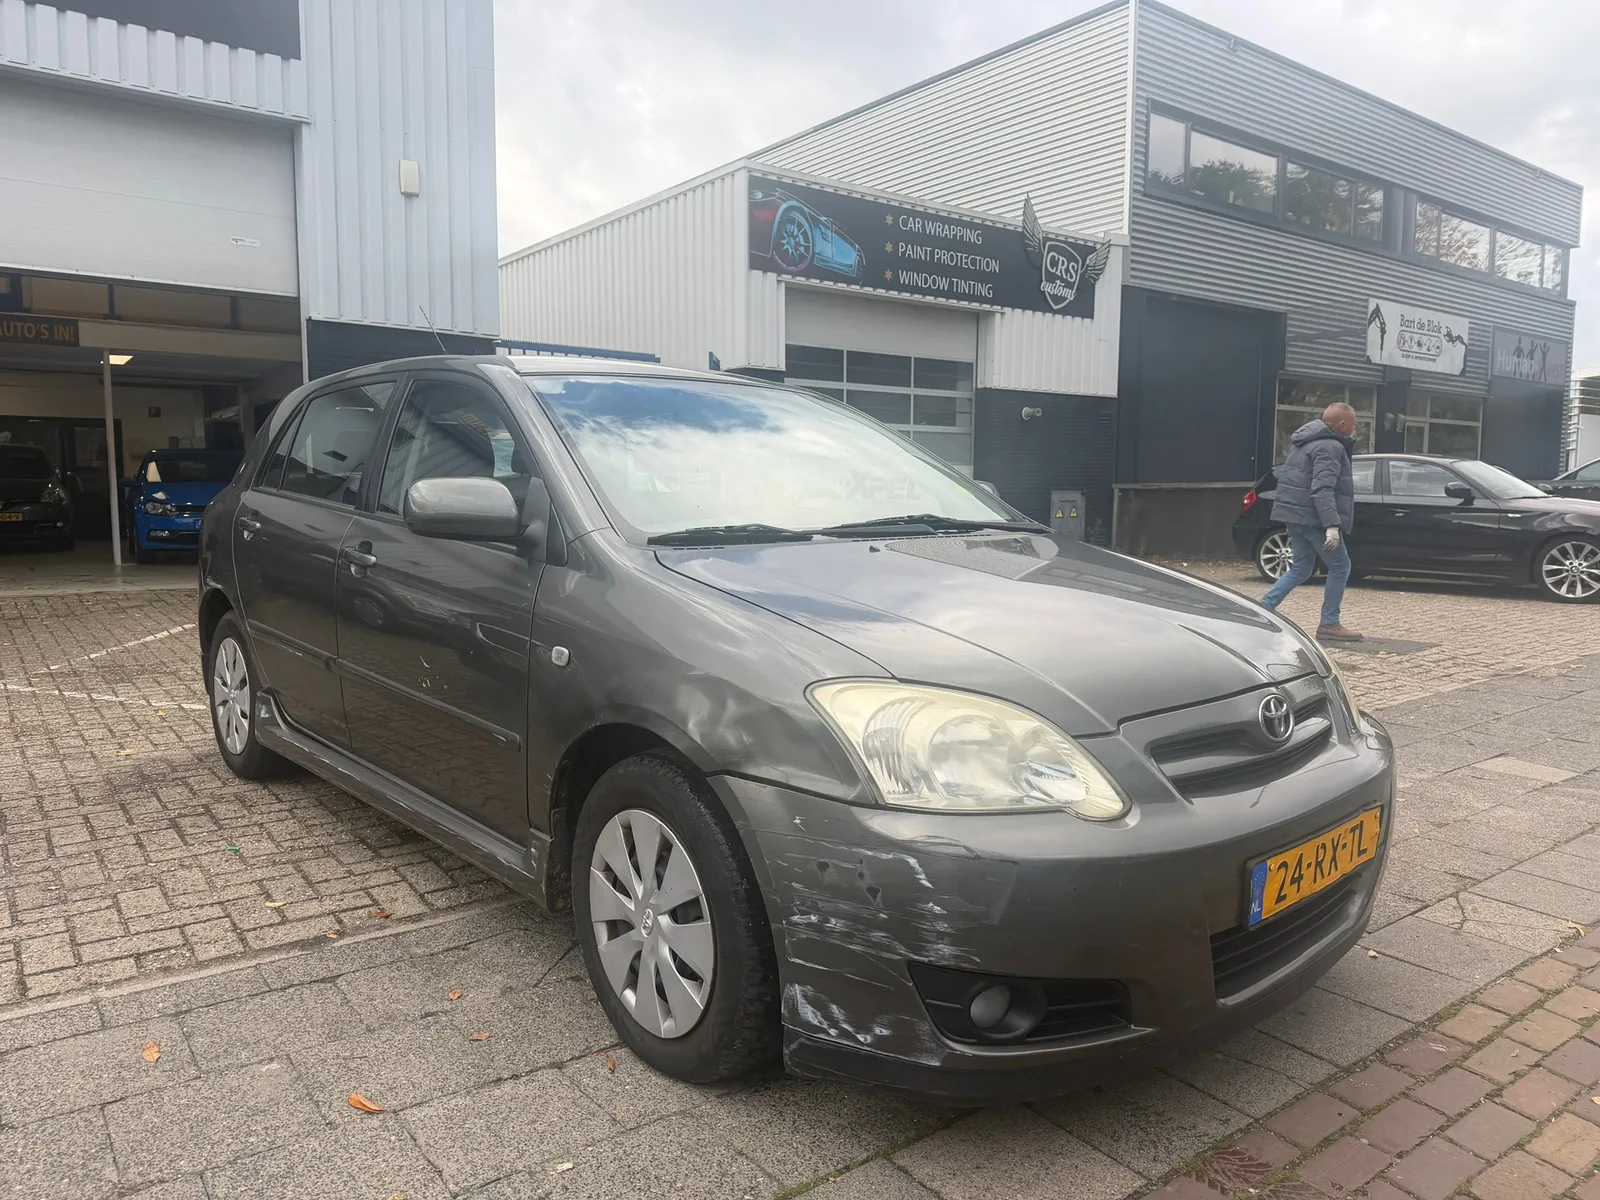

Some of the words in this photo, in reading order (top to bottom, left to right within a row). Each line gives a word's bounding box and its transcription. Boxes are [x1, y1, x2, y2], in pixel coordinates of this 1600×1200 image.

[899, 215, 922, 233] CAR
[925, 220, 982, 244] WRAPPING
[898, 242, 932, 261] PAINT
[934, 248, 1000, 273] PROTECTION
[1046, 251, 1077, 282] CRS
[898, 269, 949, 291] WINDOW
[951, 278, 993, 298] TINTING
[1040, 279, 1077, 301] customs
[54, 324, 75, 341] IN!
[1400, 314, 1416, 330] Bart
[1416, 318, 1426, 331] de
[1426, 319, 1442, 334] Blok
[1250, 899, 1261, 915] NL
[1274, 820, 1368, 905] 24-RX-TL
